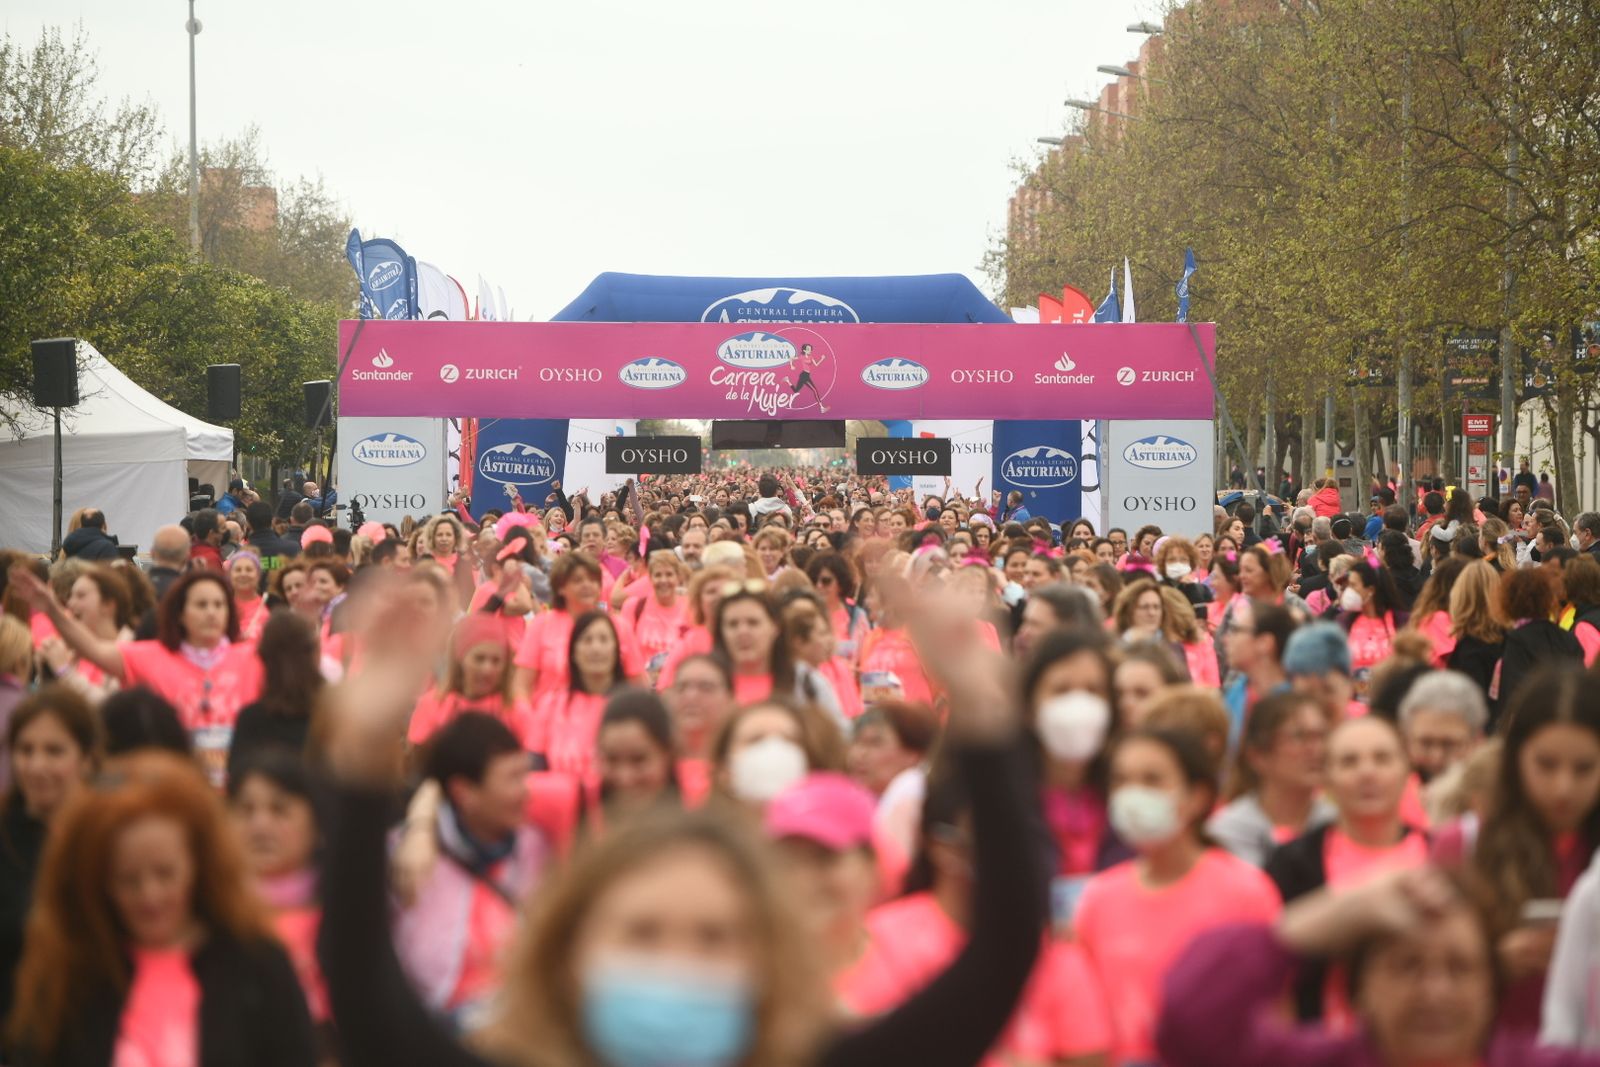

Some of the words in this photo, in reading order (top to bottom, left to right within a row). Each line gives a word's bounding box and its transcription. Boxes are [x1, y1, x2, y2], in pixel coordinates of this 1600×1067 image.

[738, 308, 789, 316] CENTRAL
[792, 308, 843, 316] LECHERA
[724, 344, 791, 360] ASTURIANA
[352, 368, 413, 382] Santander
[465, 368, 518, 380] ZURICH
[539, 367, 602, 382] OYSHO
[625, 368, 681, 381] ASTURIANA
[710, 366, 777, 387] Carrera
[867, 369, 923, 382] ASTURIANA
[951, 369, 1014, 384] OYSHO
[1034, 372, 1095, 385] Santander
[1142, 371, 1195, 382] ZURICH
[725, 390, 738, 401] de
[740, 386, 750, 401] la
[748, 386, 800, 416] Mujer
[358, 445, 421, 459] ASTURIANA
[566, 441, 605, 454] YSHO
[1129, 447, 1191, 461] ASTURIANA
[621, 448, 689, 464] OYSHO
[871, 449, 938, 465] OYSHO
[482, 456, 550, 477] ASTURIANA
[1006, 461, 1074, 477] ASTURIANA
[354, 493, 426, 510] OYSHO
[1123, 495, 1197, 512] OYSHO
